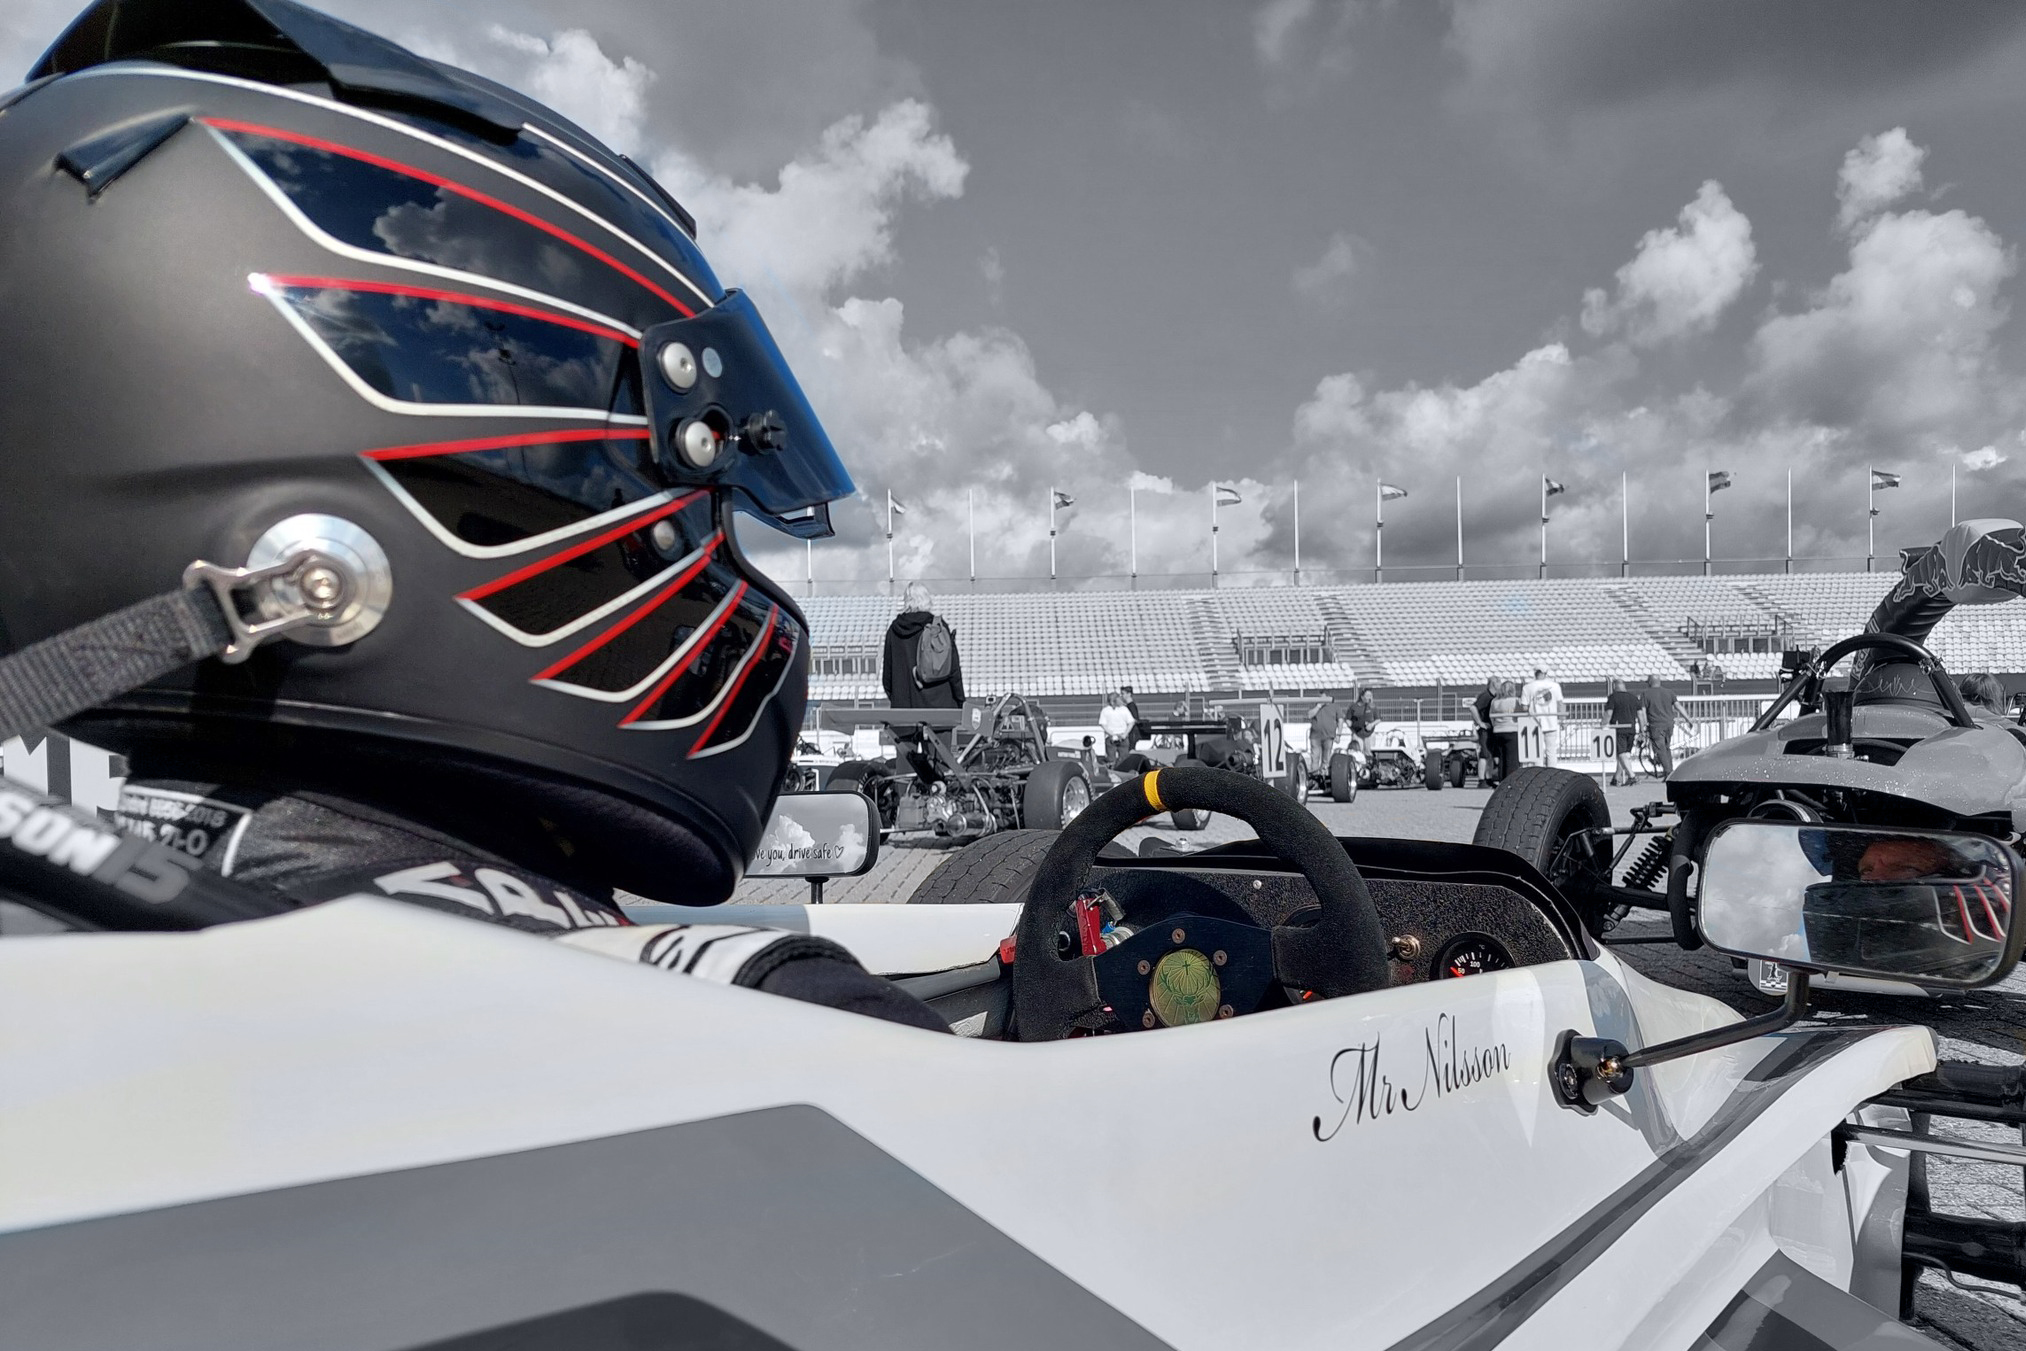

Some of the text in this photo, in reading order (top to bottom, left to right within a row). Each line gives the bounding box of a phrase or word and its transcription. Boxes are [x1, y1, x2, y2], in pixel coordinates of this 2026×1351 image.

[1264, 718, 1284, 772] 12
[1520, 725, 1540, 758] 11
[1592, 735, 1615, 758] 10
[754, 843, 832, 867] ve you, drive safe
[1312, 1012, 1511, 1142] Mr Nilsson
